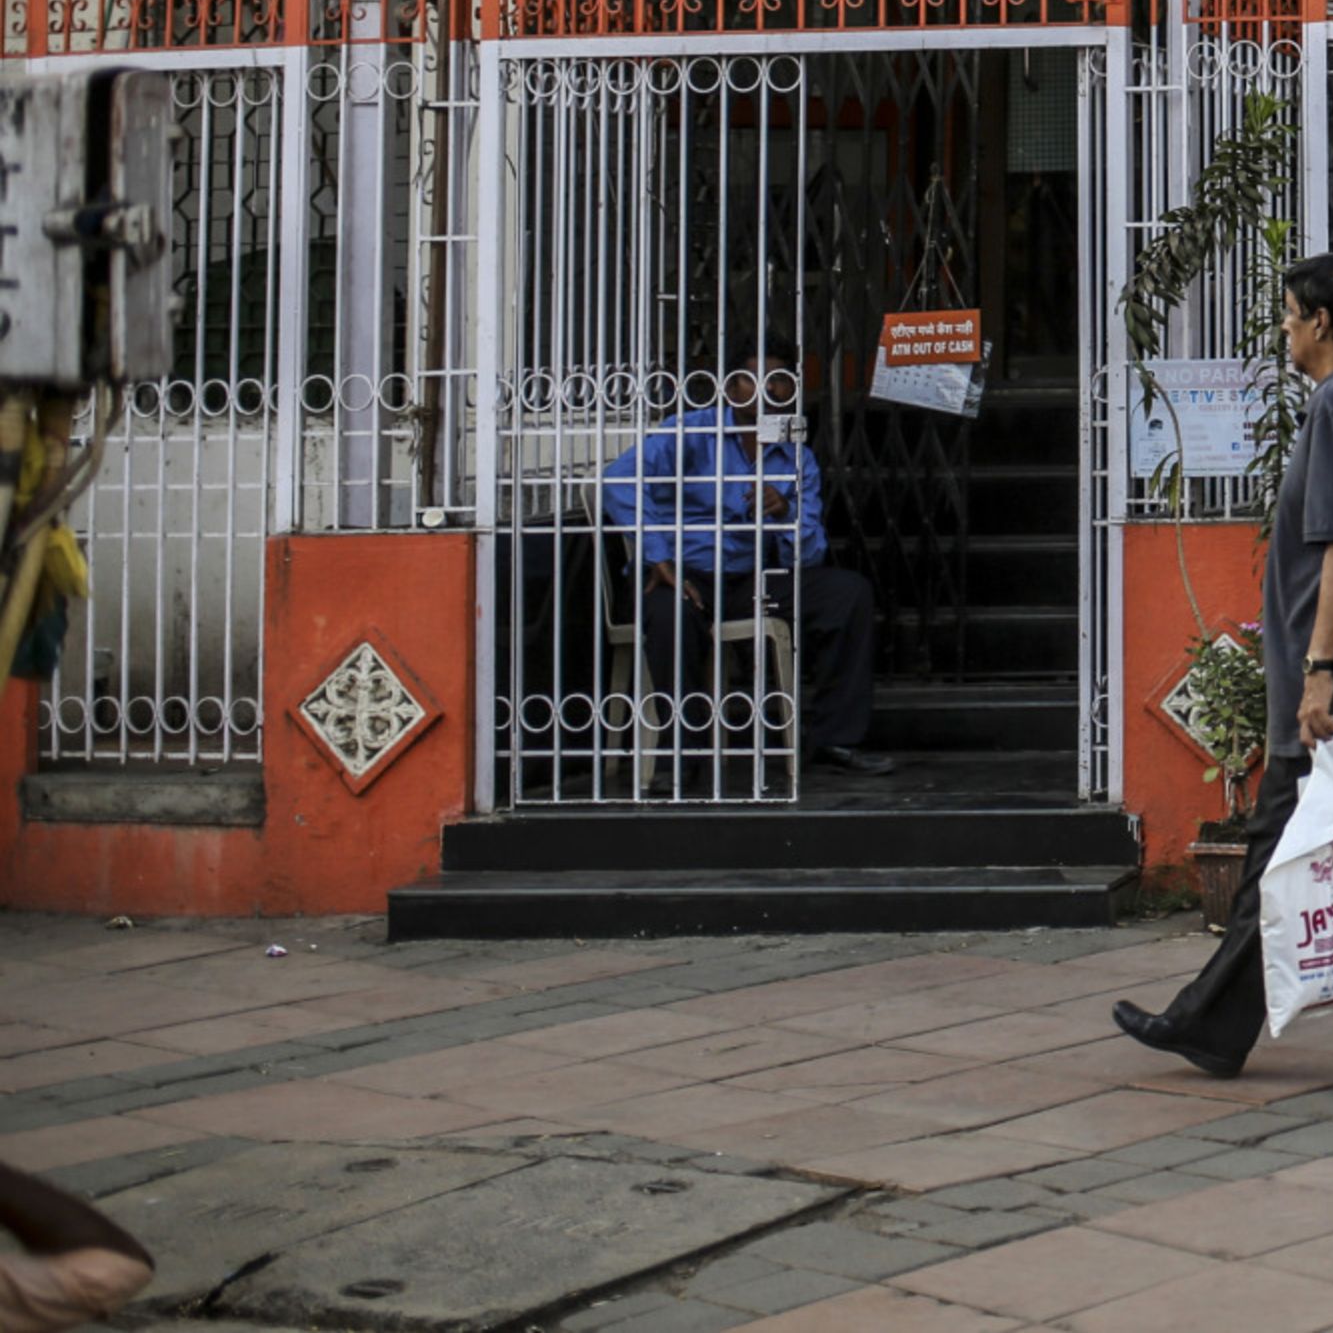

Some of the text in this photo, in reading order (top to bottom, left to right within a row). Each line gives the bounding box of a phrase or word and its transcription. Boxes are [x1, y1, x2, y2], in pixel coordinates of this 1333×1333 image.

[891, 340, 975, 356] ATM OUT OF CASH
[1167, 367, 1194, 384] NO
